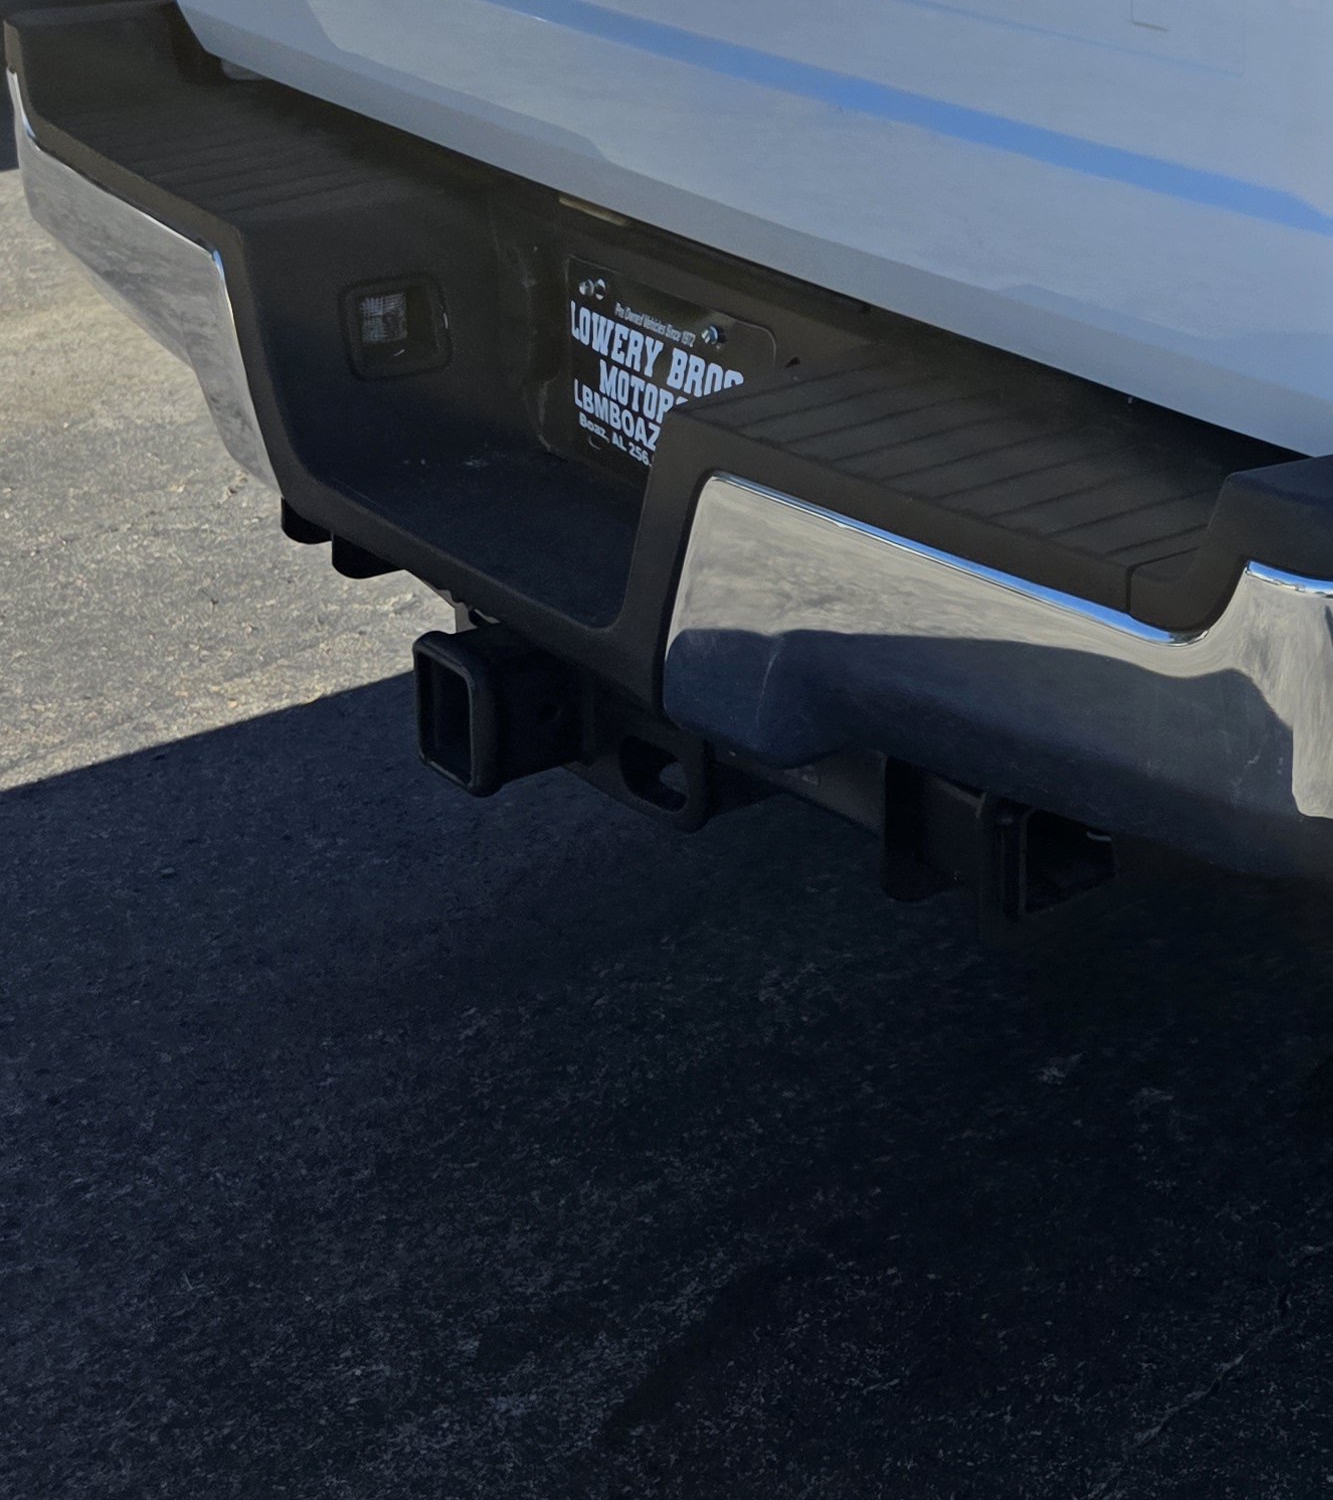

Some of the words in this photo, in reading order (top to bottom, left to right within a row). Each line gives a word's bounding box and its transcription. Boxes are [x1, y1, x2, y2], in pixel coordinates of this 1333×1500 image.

[570, 300, 664, 378] LOWERY
[574, 378, 661, 452] LBMBOAZ
[599, 359, 690, 425] MOTOR
[578, 411, 611, 444] Boaz,
[611, 431, 628, 452] AL
